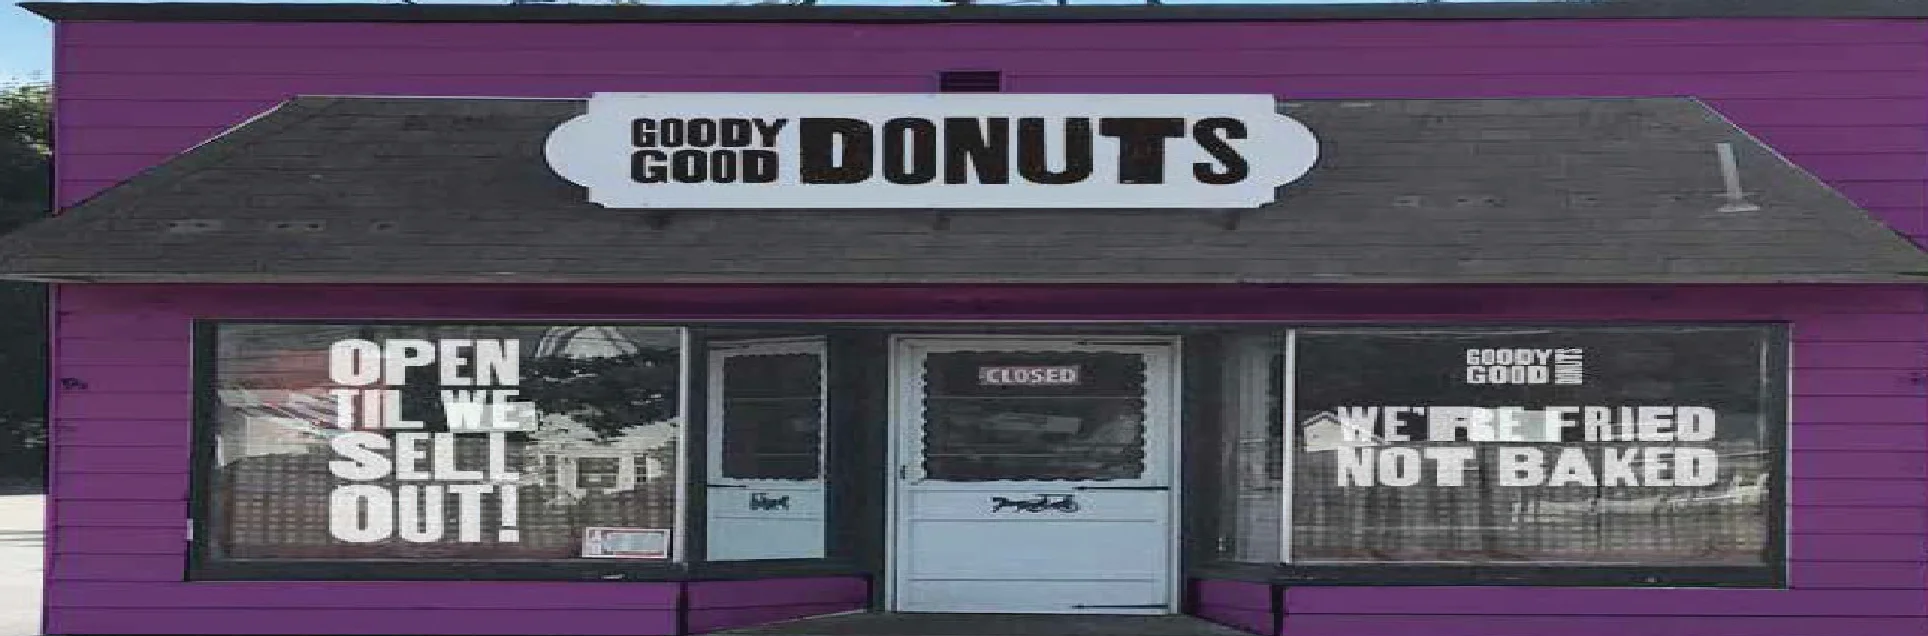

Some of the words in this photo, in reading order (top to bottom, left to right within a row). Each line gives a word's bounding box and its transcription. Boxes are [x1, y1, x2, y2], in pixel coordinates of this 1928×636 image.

[631, 118, 788, 147] GOODY
[800, 117, 1248, 184] DONUTS
[631, 150, 778, 183] GOOD
[329, 338, 519, 386] OPEN
[1466, 348, 1552, 365] GOODY
[1466, 365, 1549, 384] GOOD
[986, 368, 1076, 384] CLOSED
[331, 389, 423, 428] TIL
[441, 389, 520, 428] WE
[1337, 406, 1532, 441] WE'RE
[1546, 406, 1716, 441] FRIED
[329, 432, 520, 480] SELL
[1337, 446, 1476, 487] NOT
[1499, 446, 1719, 487] BAKED
[329, 484, 520, 543] OUT!
